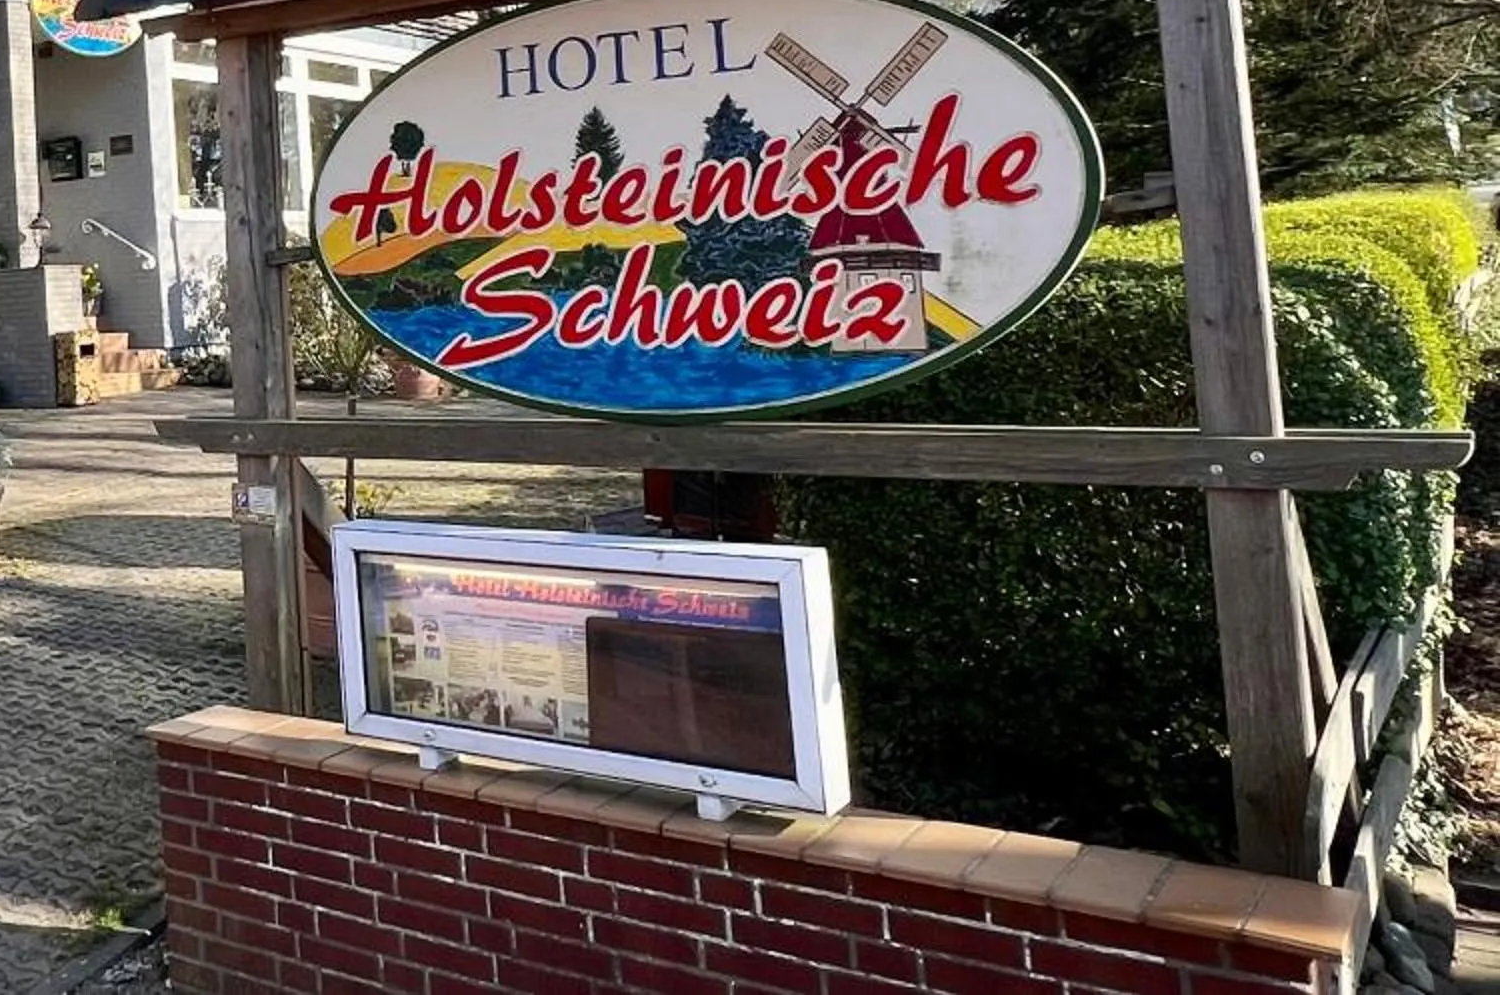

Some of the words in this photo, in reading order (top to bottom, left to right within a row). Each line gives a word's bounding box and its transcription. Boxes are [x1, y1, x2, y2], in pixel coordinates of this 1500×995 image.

[495, 17, 757, 98] HOTEL
[330, 94, 1041, 241] Holsteinische
[440, 244, 908, 365] Schweiz
